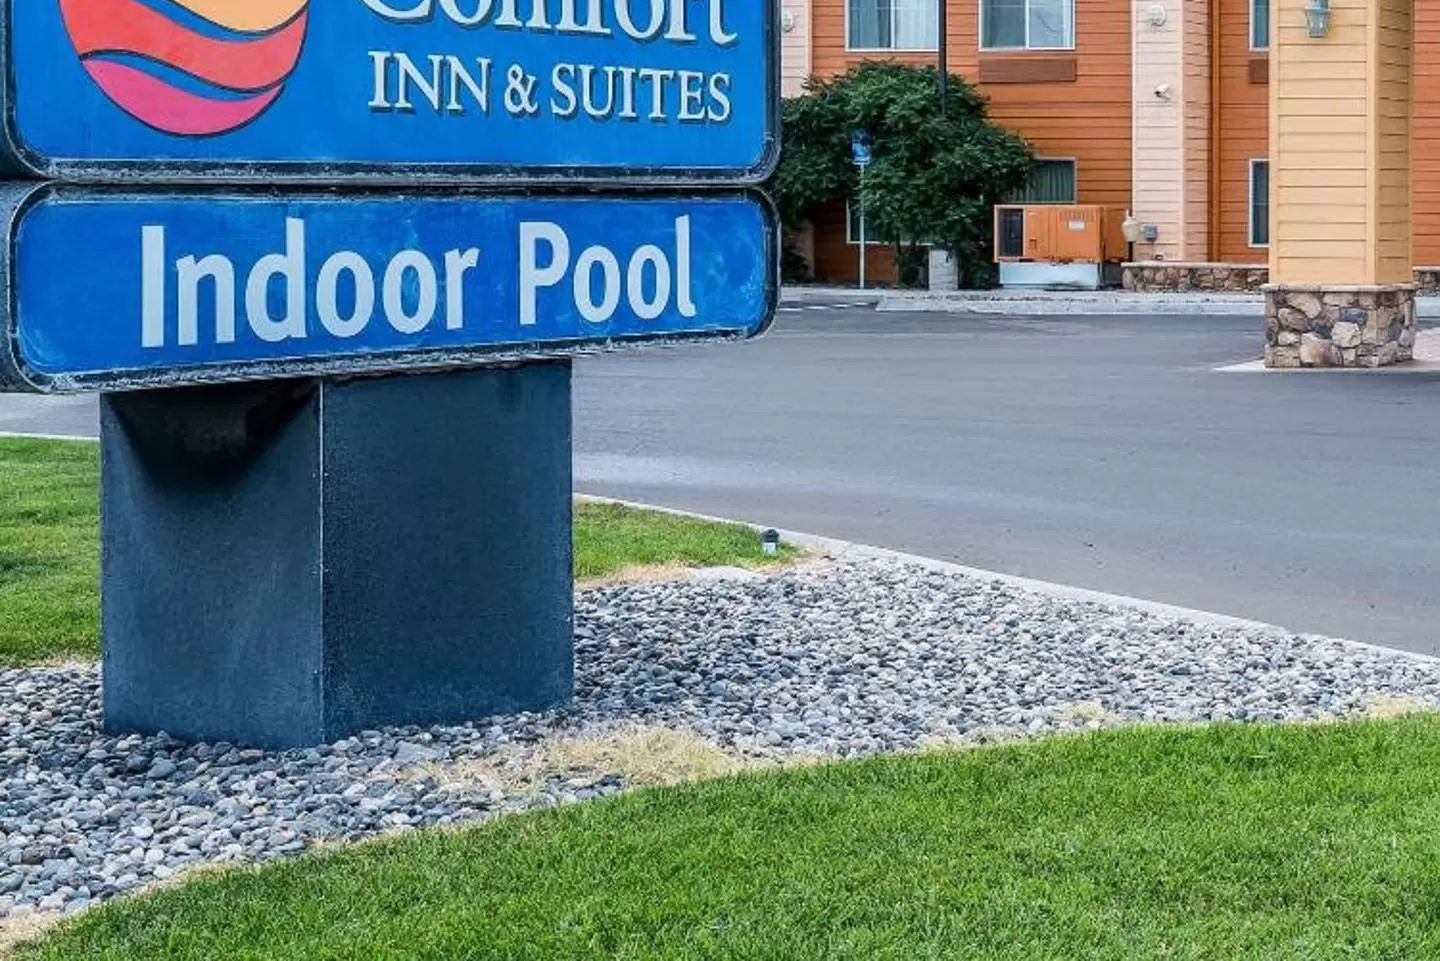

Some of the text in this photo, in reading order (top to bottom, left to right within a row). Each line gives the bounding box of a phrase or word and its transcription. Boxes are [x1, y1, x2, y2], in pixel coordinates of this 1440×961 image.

[367, 51, 731, 123] INN & SUITES
[140, 214, 696, 348] Indoor Pool
